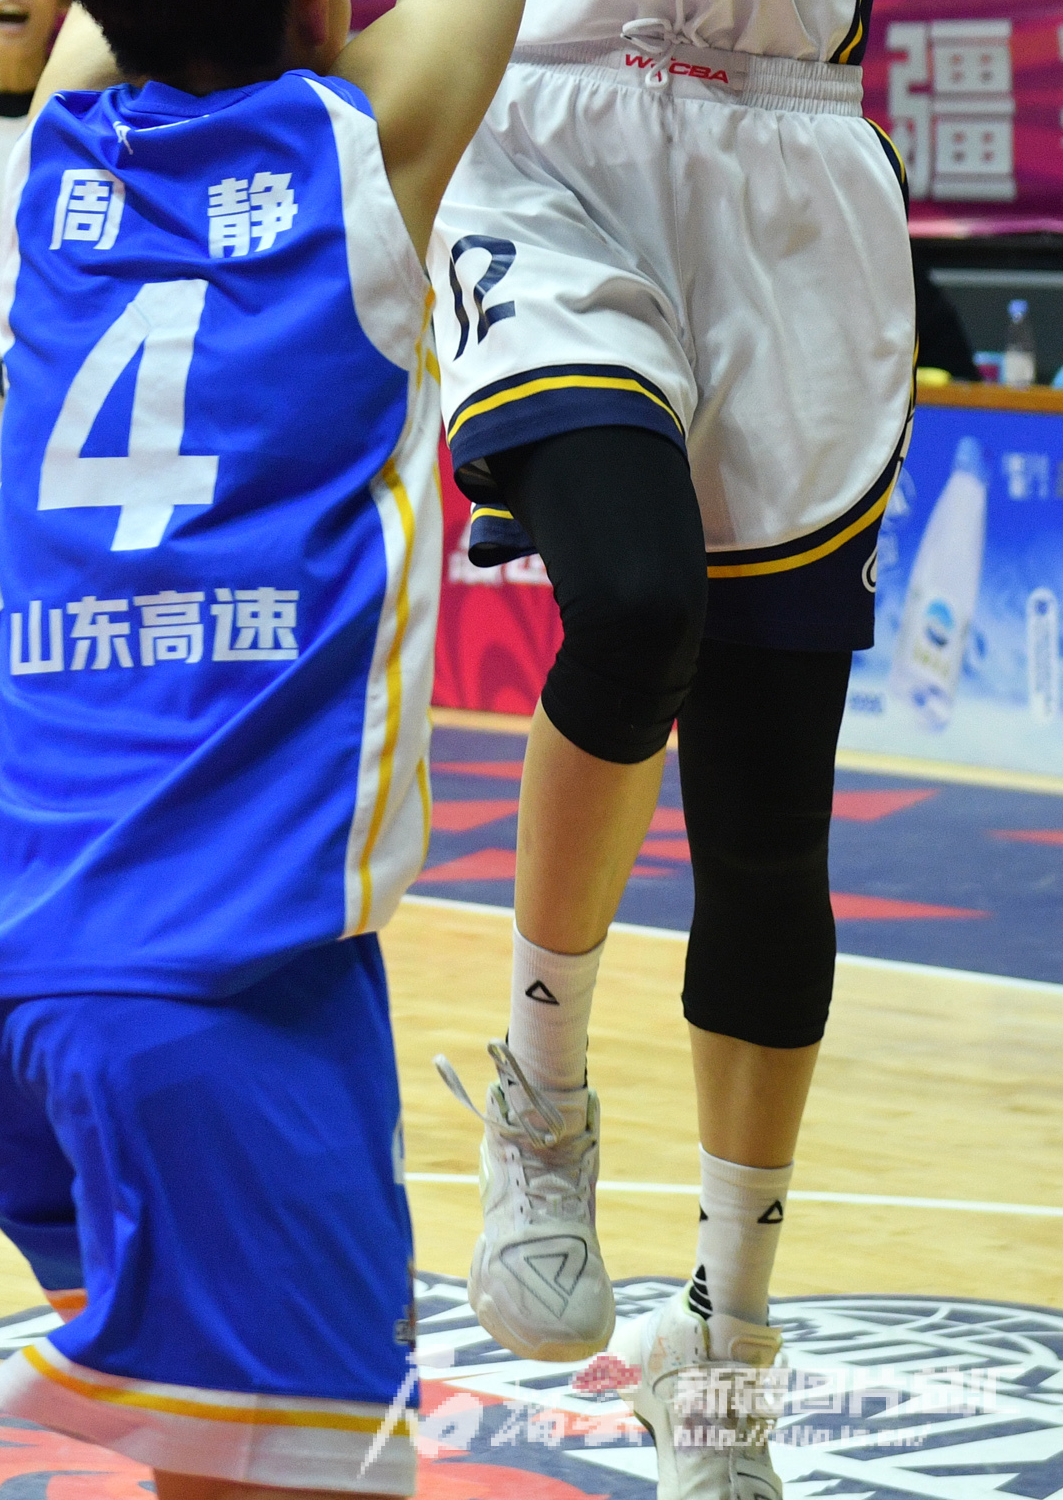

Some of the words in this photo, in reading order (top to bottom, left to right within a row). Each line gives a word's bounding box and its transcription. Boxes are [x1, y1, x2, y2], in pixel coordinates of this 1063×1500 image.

[625, 53, 729, 84] WCBA
[37, 278, 220, 552] 4
[9, 587, 301, 676] 山东高速
